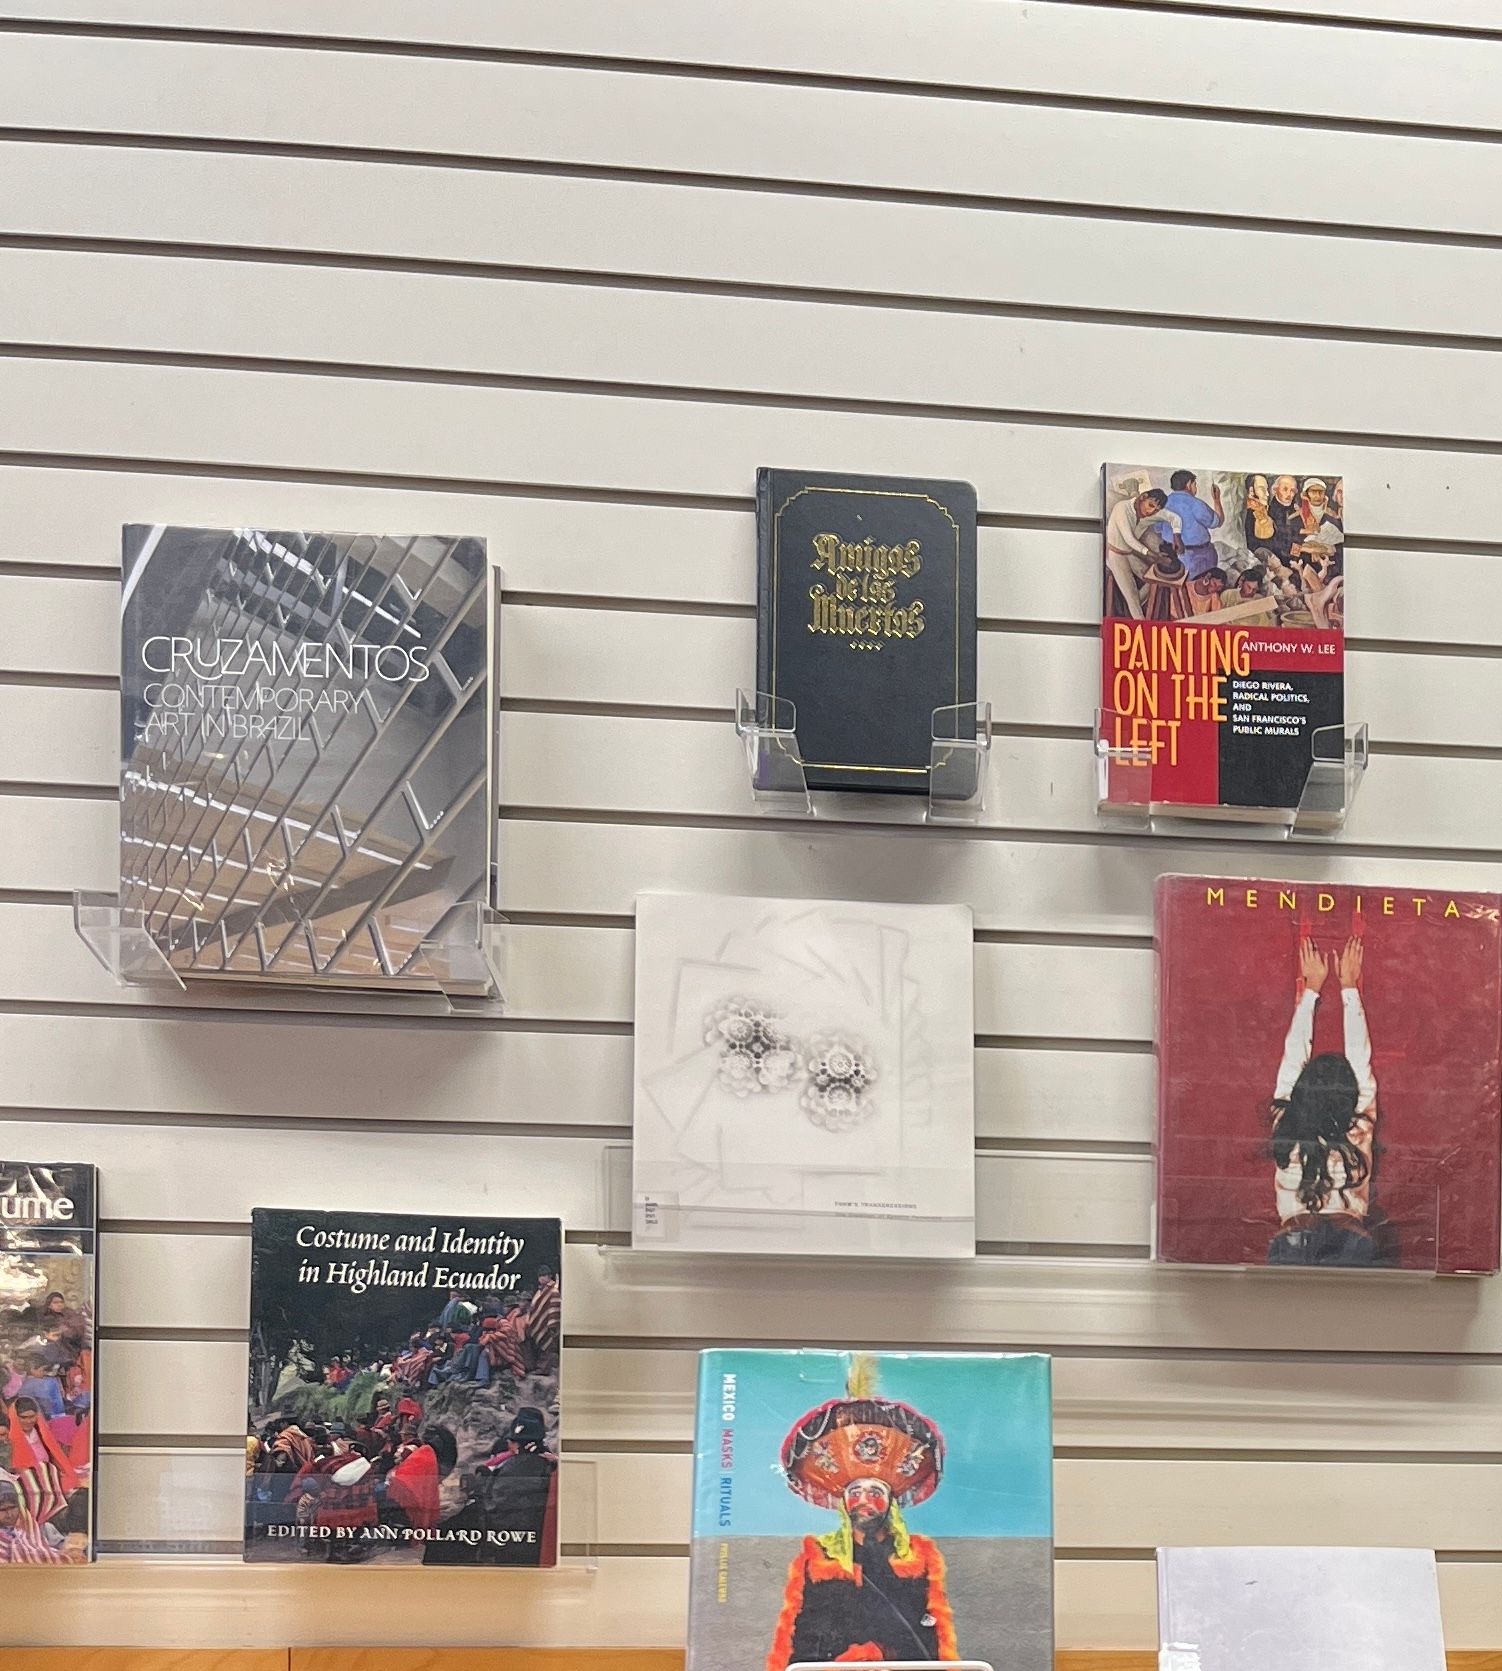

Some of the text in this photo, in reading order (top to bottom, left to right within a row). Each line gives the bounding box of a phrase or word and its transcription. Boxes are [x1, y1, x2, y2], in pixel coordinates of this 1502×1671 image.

[142, 636, 430, 682] CRUZAMENTOS
[1114, 622, 1250, 677] PAINTING
[1242, 641, 1335, 655] ANTHONY W. LEE
[143, 682, 364, 714] CONTEMPORARY
[1114, 670, 1227, 722] ON THE
[1232, 681, 1293, 692] DIEGO RIVERA,
[1232, 692, 1310, 704] RADICAL POLITICS,
[1232, 703, 1252, 712] AND
[1232, 714, 1306, 725] SAN FRANCISCO'S
[145, 713, 311, 741] ART IN BRAZIL
[1115, 716, 1181, 766] LEFT
[1232, 726, 1299, 736] PUBLIC MURALS
[1207, 888, 1460, 918] MENDIETA
[2, 1197, 75, 1220] ume
[296, 1226, 525, 1264] Costume and Identity
[298, 1259, 521, 1294] in Highland Ecuador
[723, 1373, 736, 1421] MEXICO
[721, 1429, 734, 1468] MASKS
[719, 1477, 732, 1527] RITUALS
[267, 1524, 537, 1546] EDITED BY ANN POLLARD ROWE
